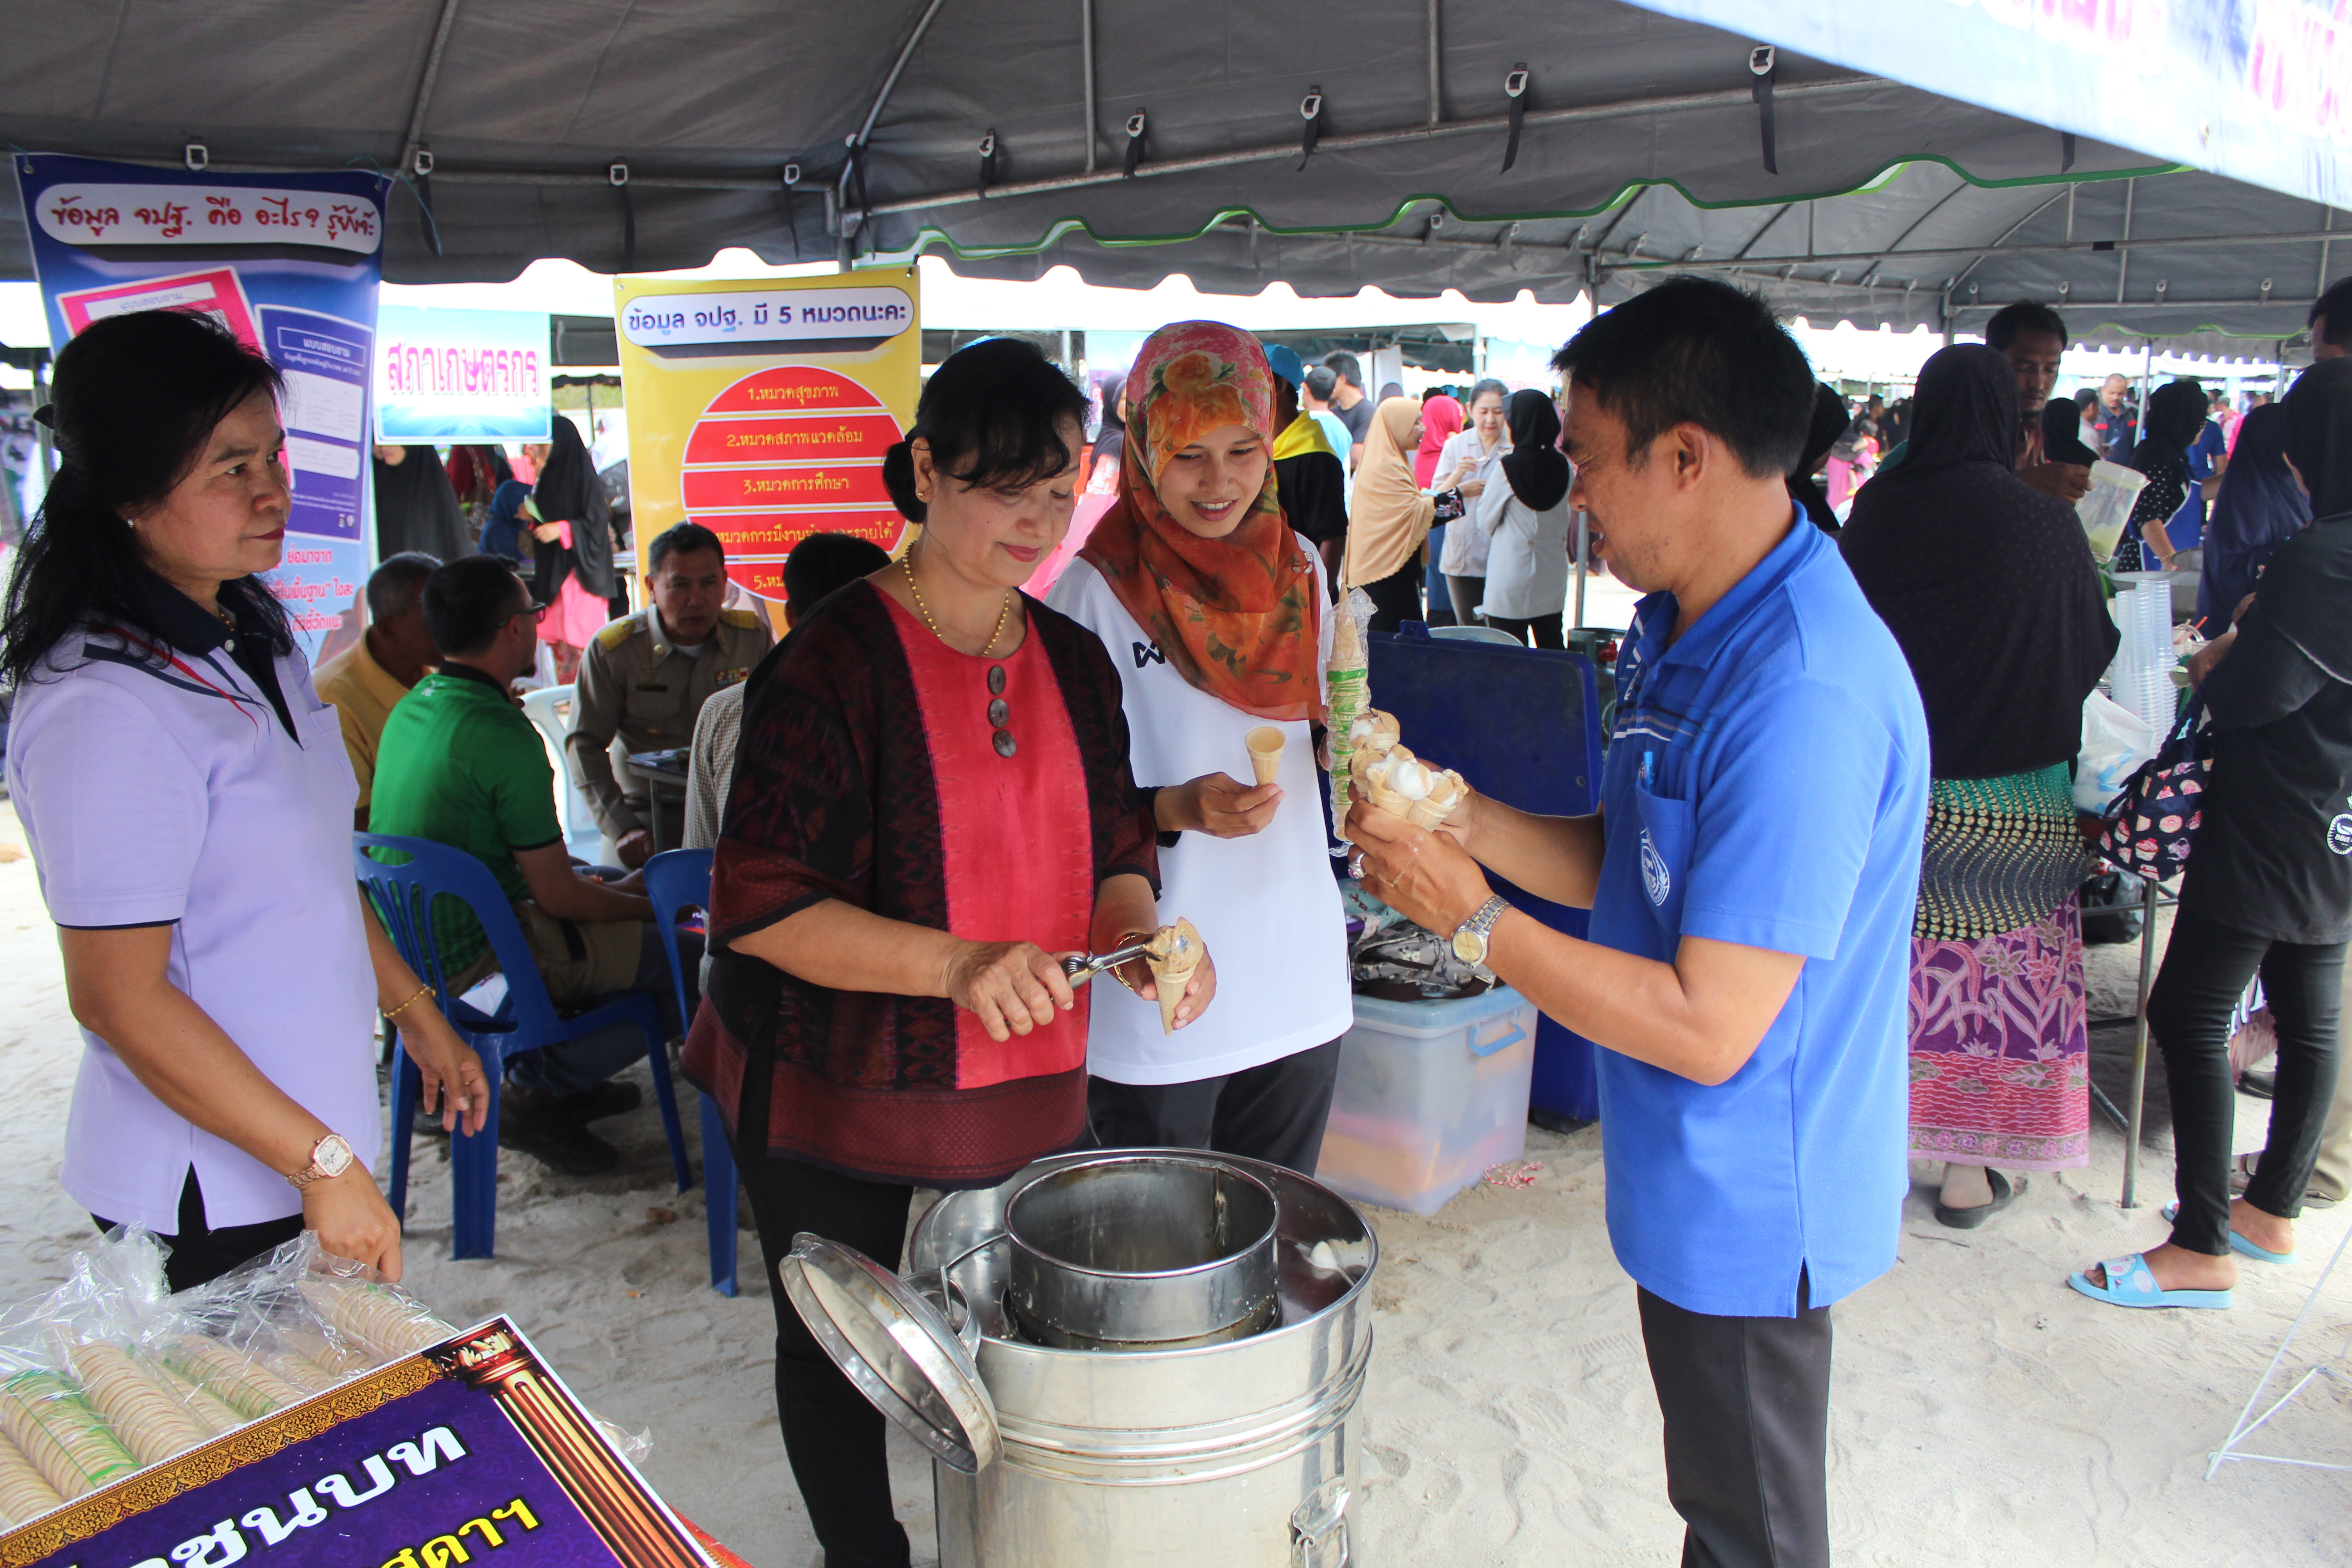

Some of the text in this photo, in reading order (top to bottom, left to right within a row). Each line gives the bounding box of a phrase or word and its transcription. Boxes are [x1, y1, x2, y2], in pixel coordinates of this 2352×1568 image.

[51, 195, 120, 236] ข้อมูล
[133, 201, 192, 238] จปฐ.
[629, 303, 906, 336] ข้อมูล จปฐ. มี 5 หมวดนะคะ
[388, 342, 540, 397] สภาเกษตรกร
[747, 385, 839, 405] 1.หมวดสุขภาพ
[726, 425, 862, 447] 2.หมวดสภาพแวดล้อม
[743, 471, 850, 495] 3.หมวดการศึกษา
[286, 544, 333, 564] ย่อมาจาก
